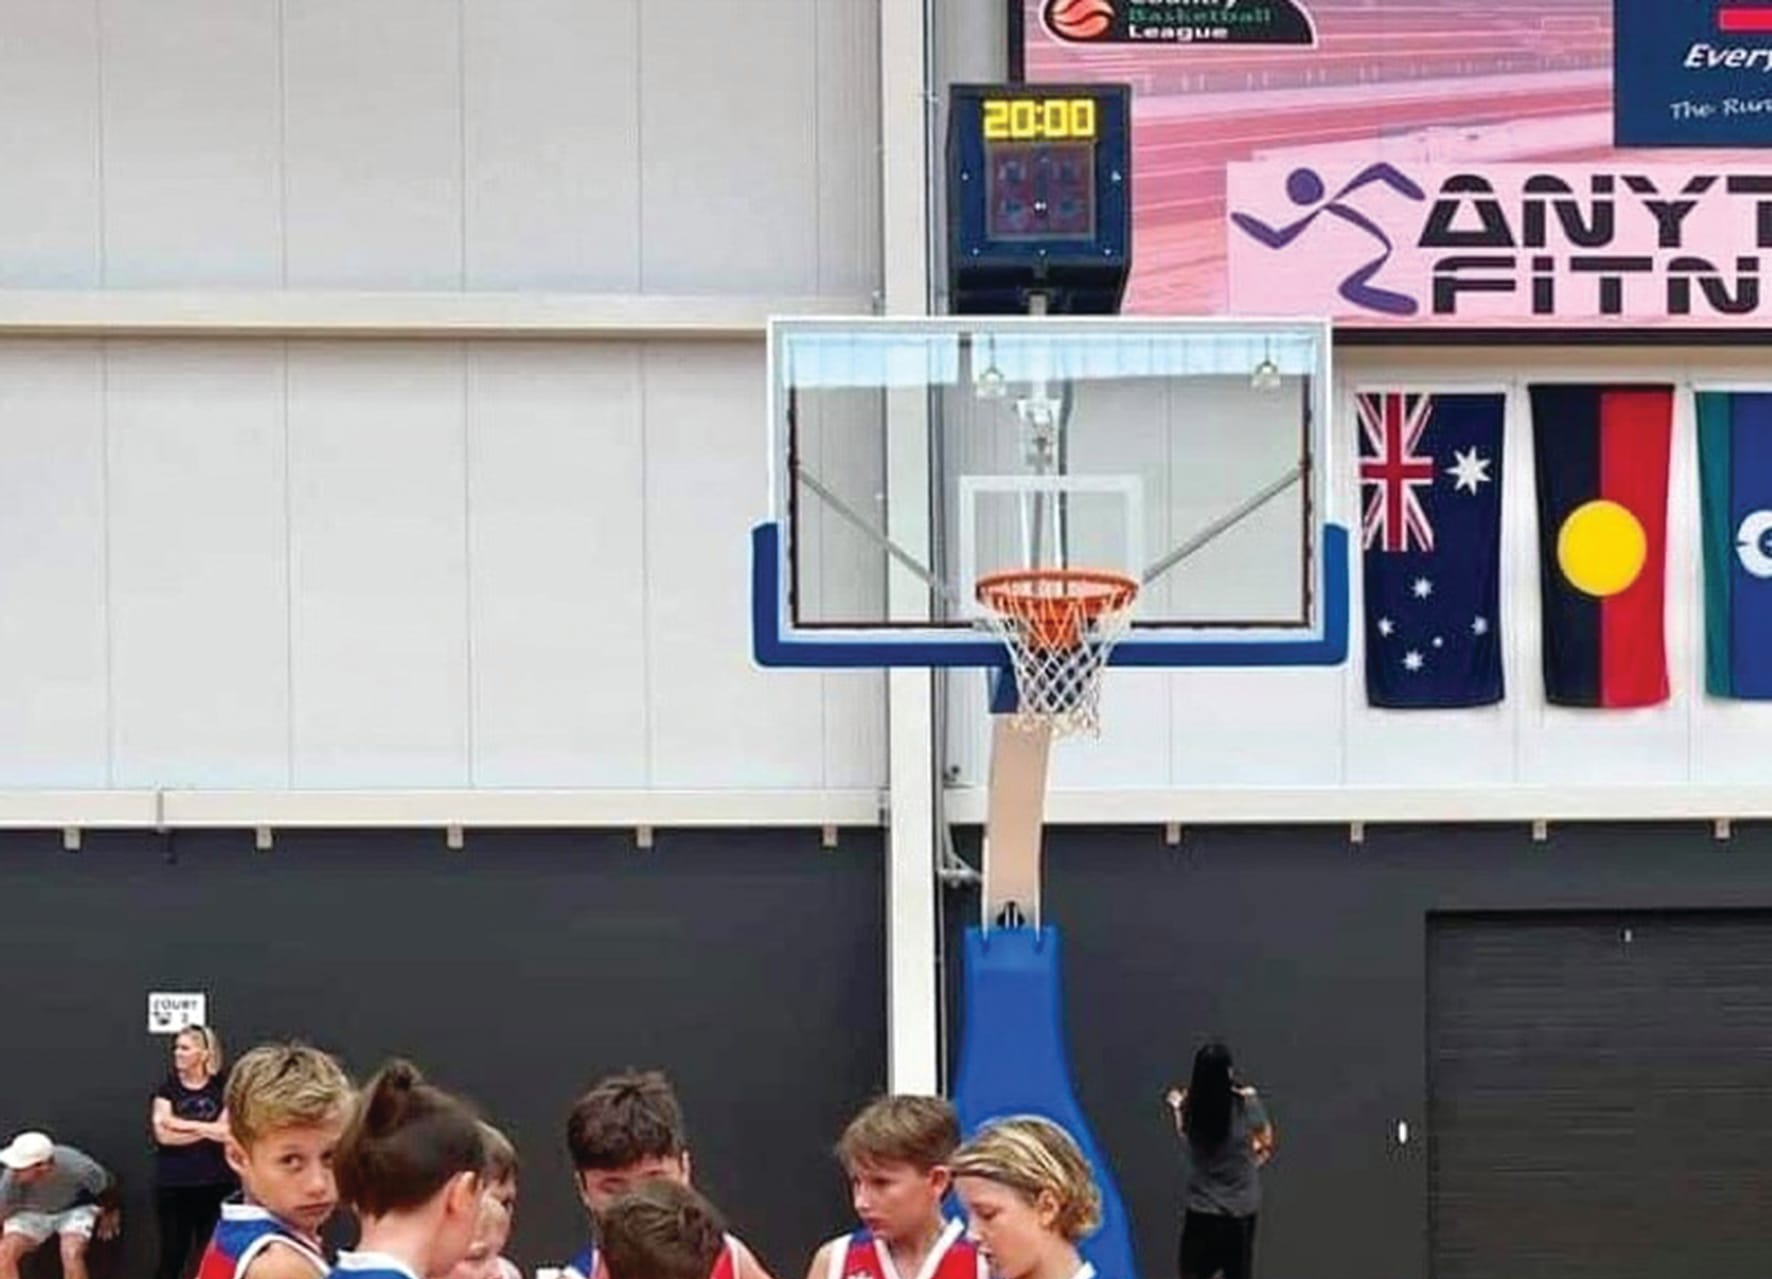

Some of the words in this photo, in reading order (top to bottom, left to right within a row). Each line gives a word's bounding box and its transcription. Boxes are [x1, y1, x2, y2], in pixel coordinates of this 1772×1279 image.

[1128, 25, 1229, 42] League
[983, 99, 1095, 138] 20:00
[1417, 174, 1772, 248] ANYT
[1432, 256, 1760, 315] FITN
